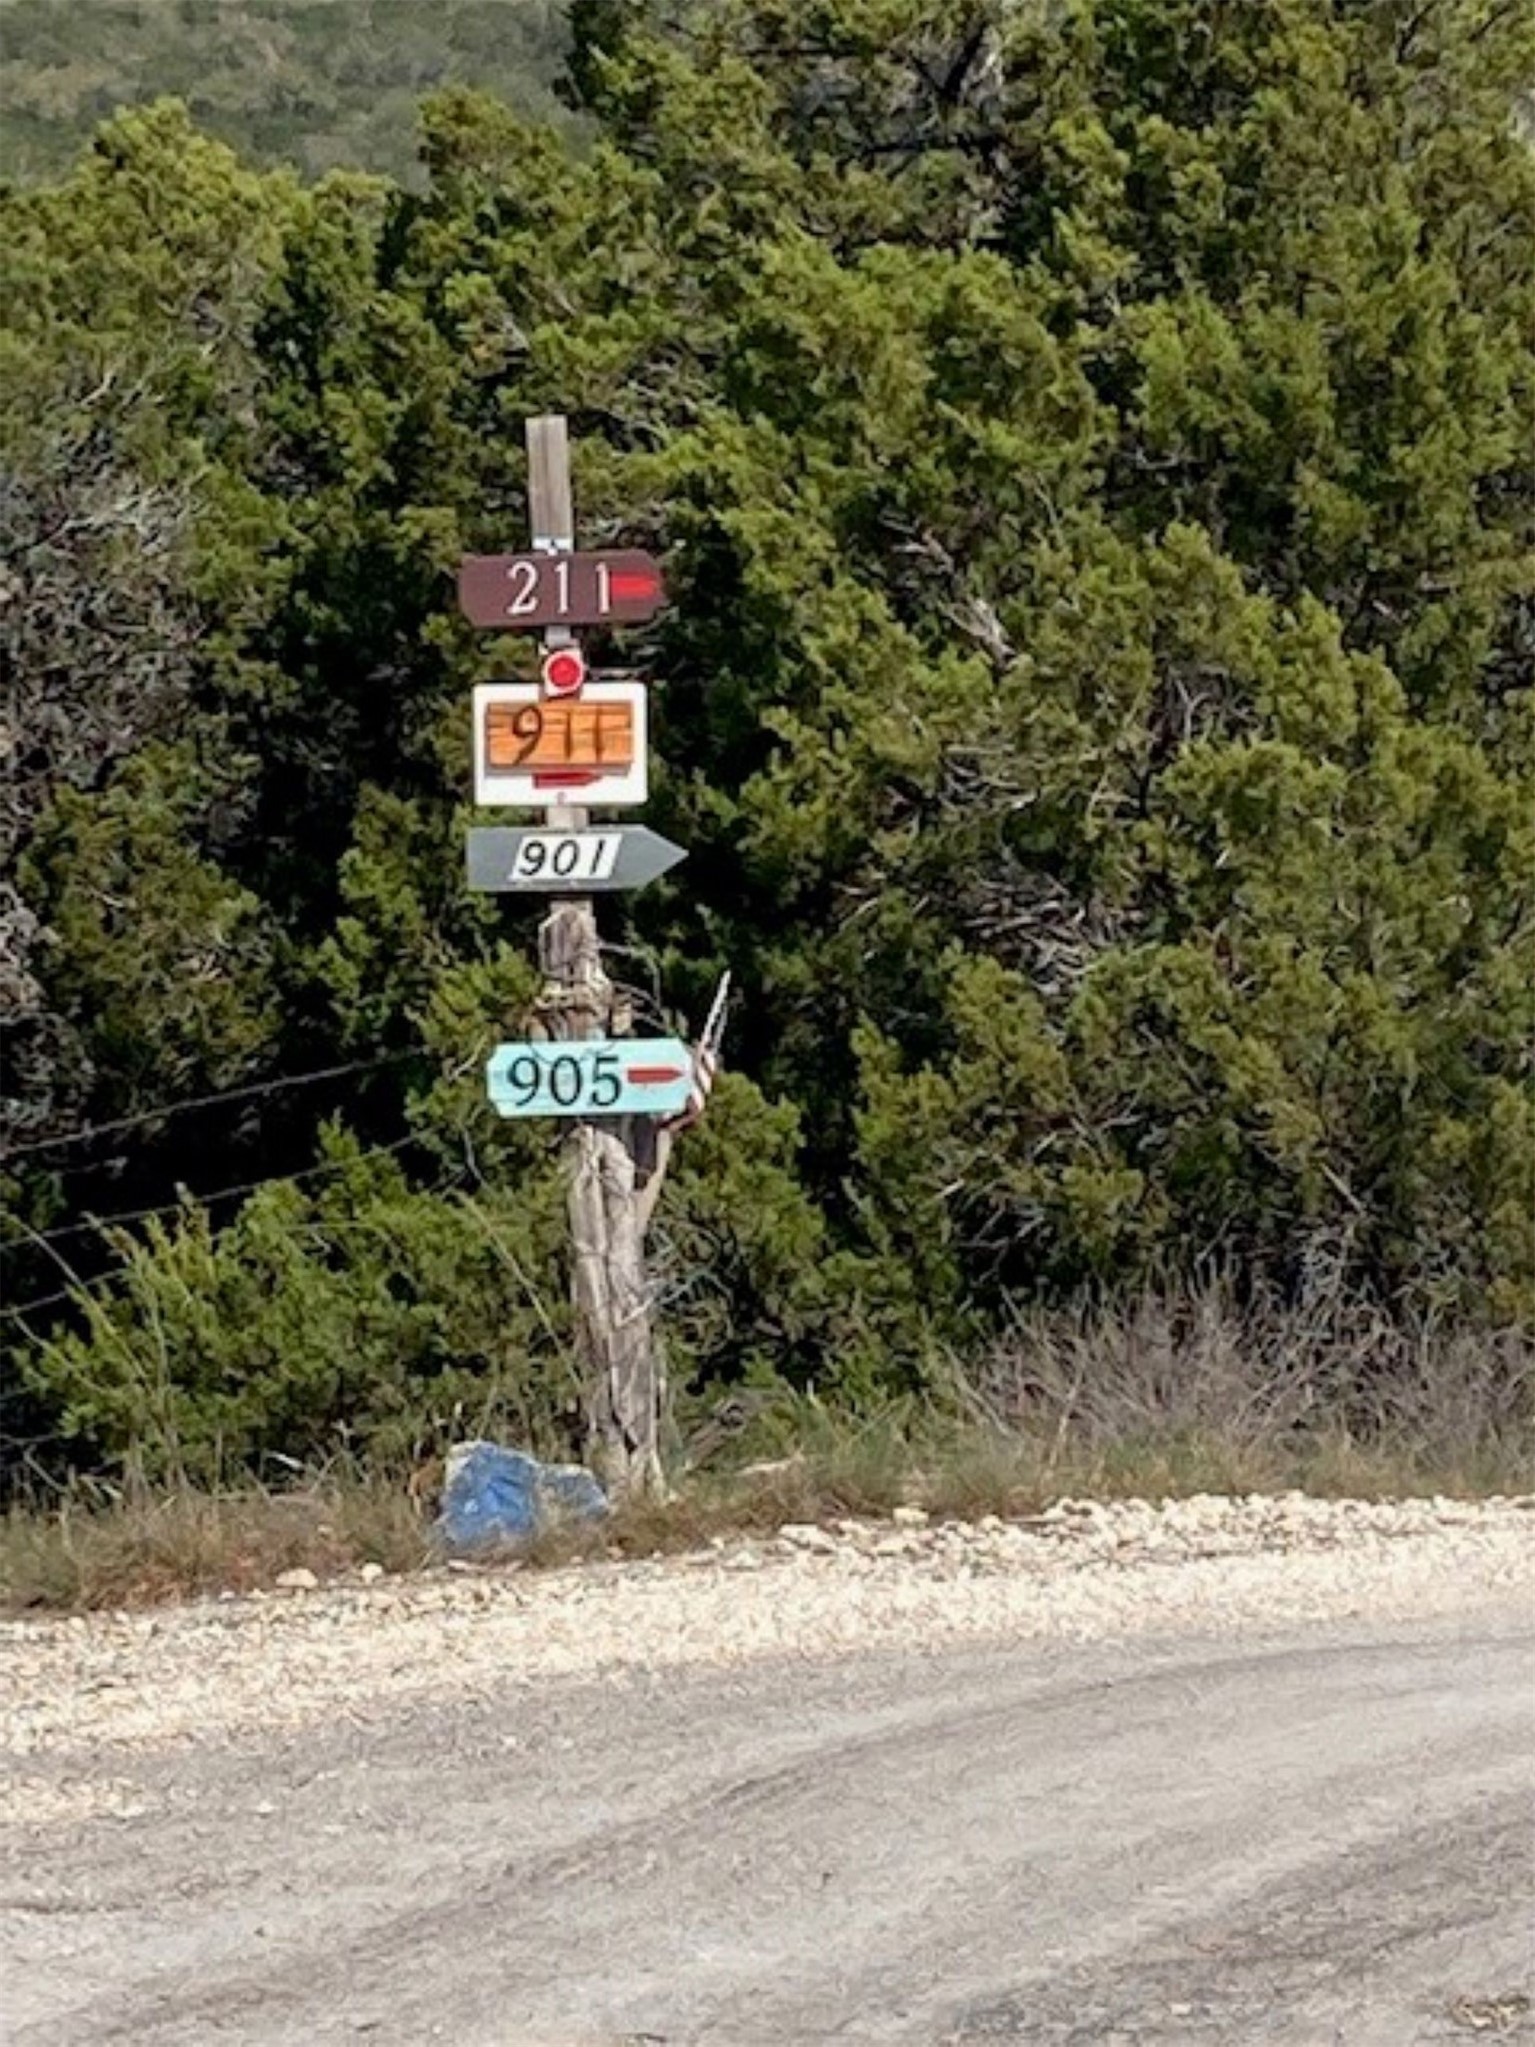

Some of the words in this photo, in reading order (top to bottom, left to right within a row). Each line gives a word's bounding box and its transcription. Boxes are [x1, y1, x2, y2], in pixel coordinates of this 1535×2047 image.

[507, 561, 610, 614] 211
[512, 705, 603, 767] 911
[518, 840, 606, 876] 901
[506, 1055, 621, 1106] 905
